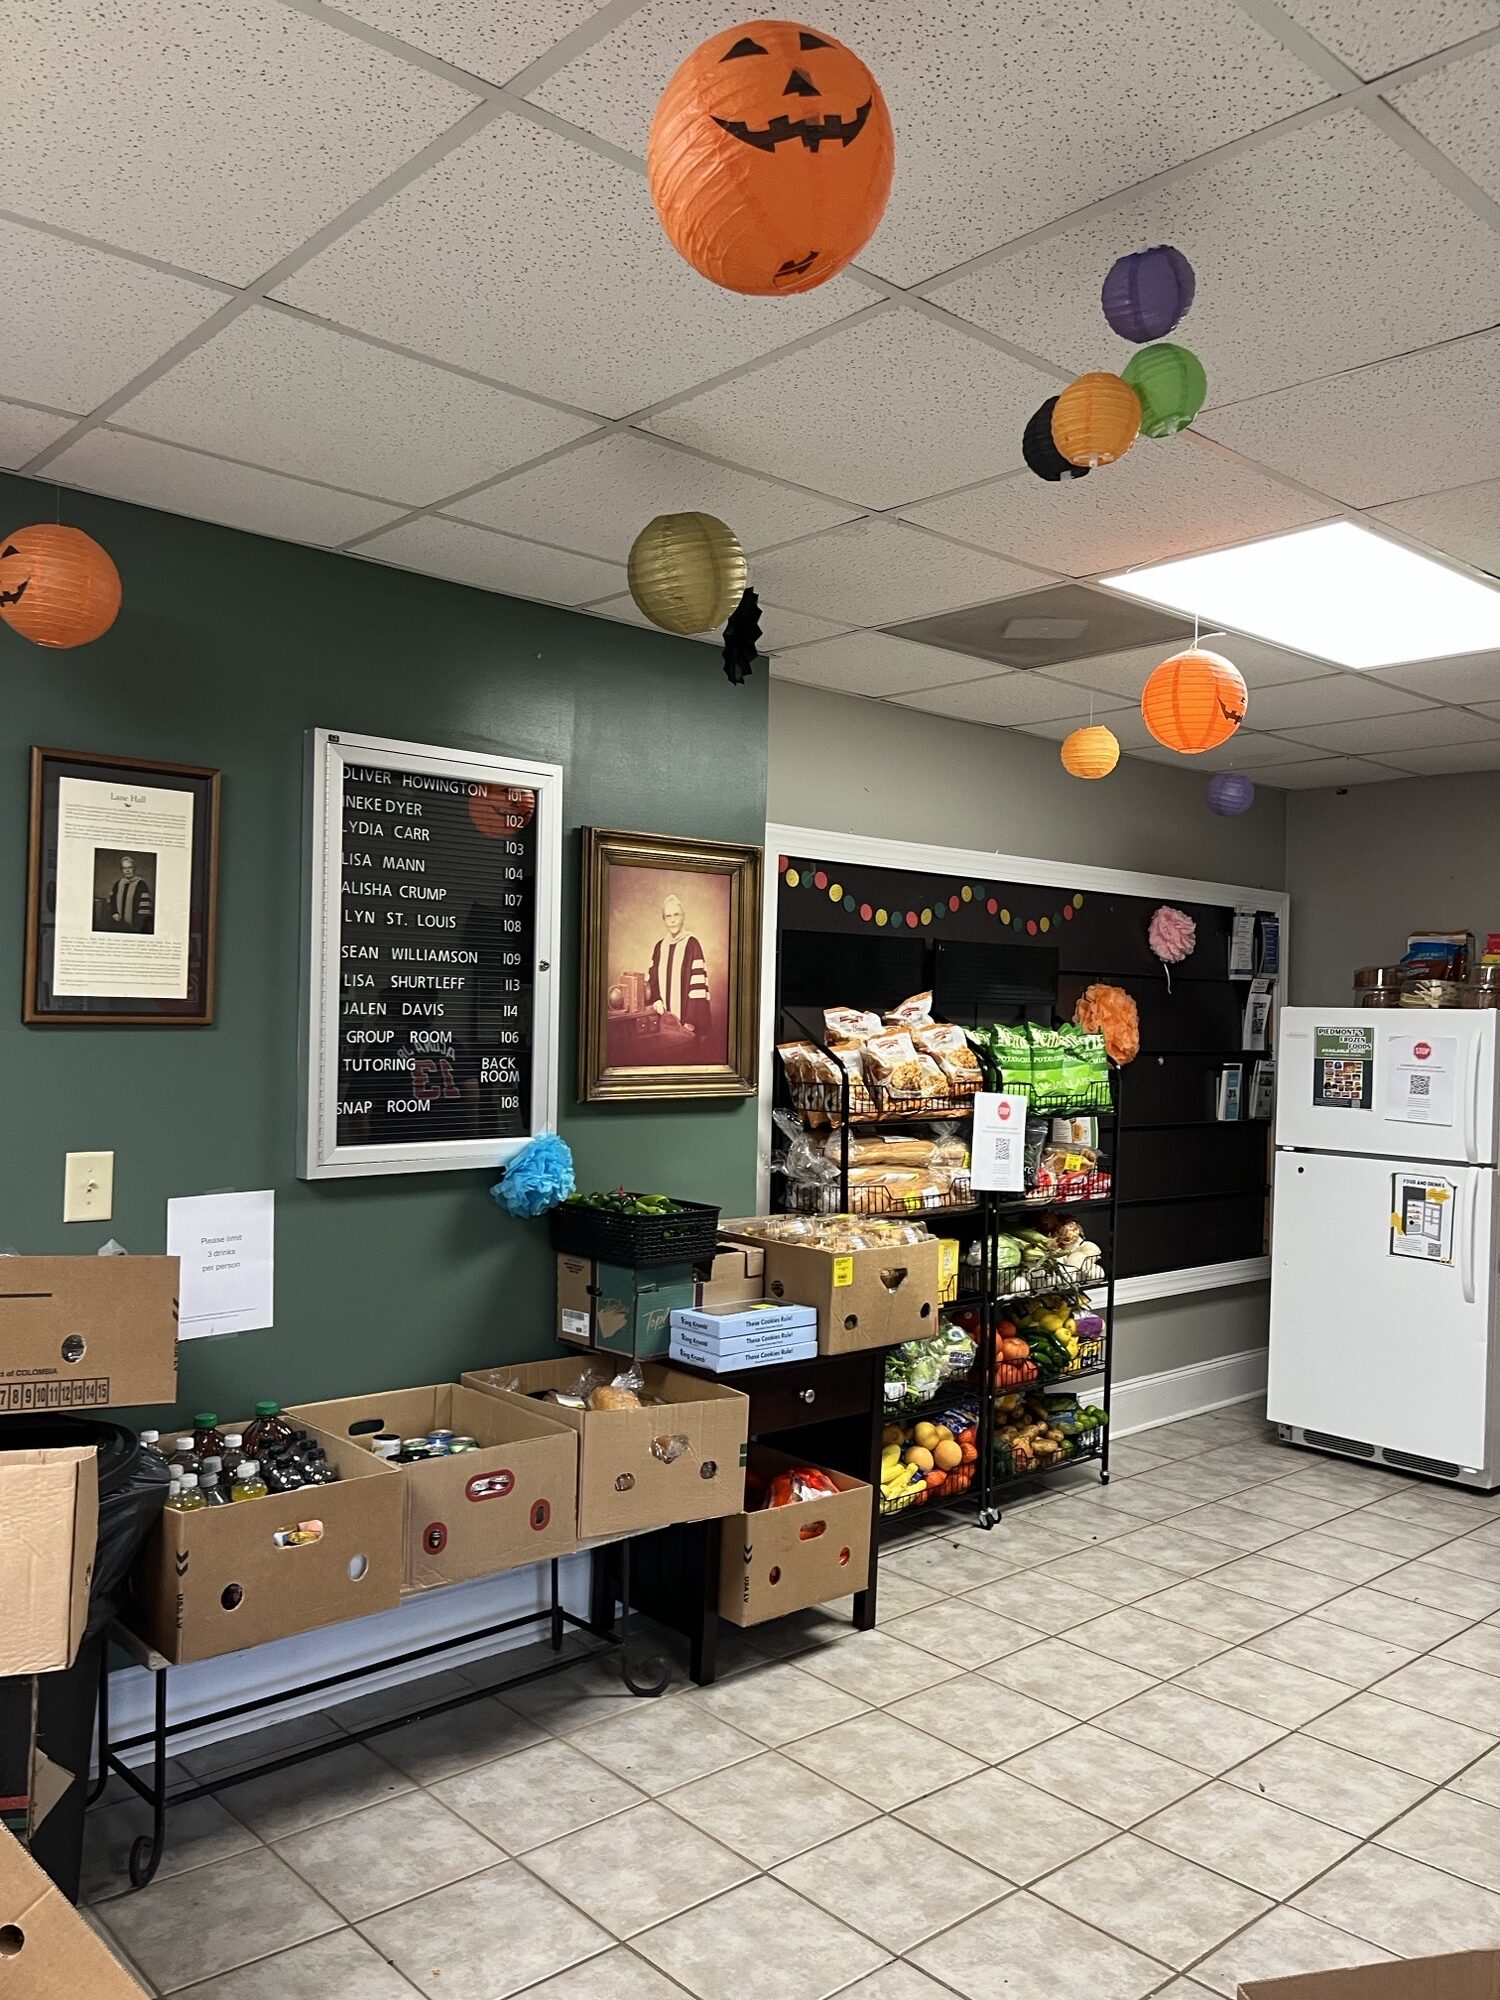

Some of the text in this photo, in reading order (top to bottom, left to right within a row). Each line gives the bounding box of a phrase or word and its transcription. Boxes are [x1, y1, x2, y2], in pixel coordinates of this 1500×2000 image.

[343, 766, 522, 802] OLIVER HOWINGTON 101
[385, 799, 422, 816] DYER
[506, 814, 524, 829] 102
[394, 825, 430, 841] CARR
[506, 840, 524, 856] 103
[342, 852, 523, 881] LISA MANN 104
[341, 881, 523, 907] ALISHA CRUMP 107
[345, 909, 521, 932] LYN ST. LOUIS 108
[341, 945, 521, 965] SEAN WILLIAMSON 109
[344, 973, 520, 991] LISA SHURTLEFF 113
[343, 1002, 518, 1017] JALEN DAVIS 114
[346, 1030, 519, 1044] GROUP ROOM 106
[343, 1057, 516, 1072] TUTORING BACK
[480, 1070, 520, 1083] ROOM
[337, 1096, 519, 1115] SNAP ROOM 108
[201, 1234, 243, 1245] Please limit
[214, 1249, 236, 1257] drinks
[202, 1261, 241, 1273] per person
[760, 1317, 780, 1326] Cookies
[781, 1315, 793, 1323] Rule!
[761, 1334, 780, 1343] Cookies
[781, 1331, 793, 1339] Rule!
[760, 1350, 780, 1359] Cookies
[781, 1347, 793, 1355] Rule!
[0, 1383, 107, 1405] 7 8 9 10 11 12 13 14 15
